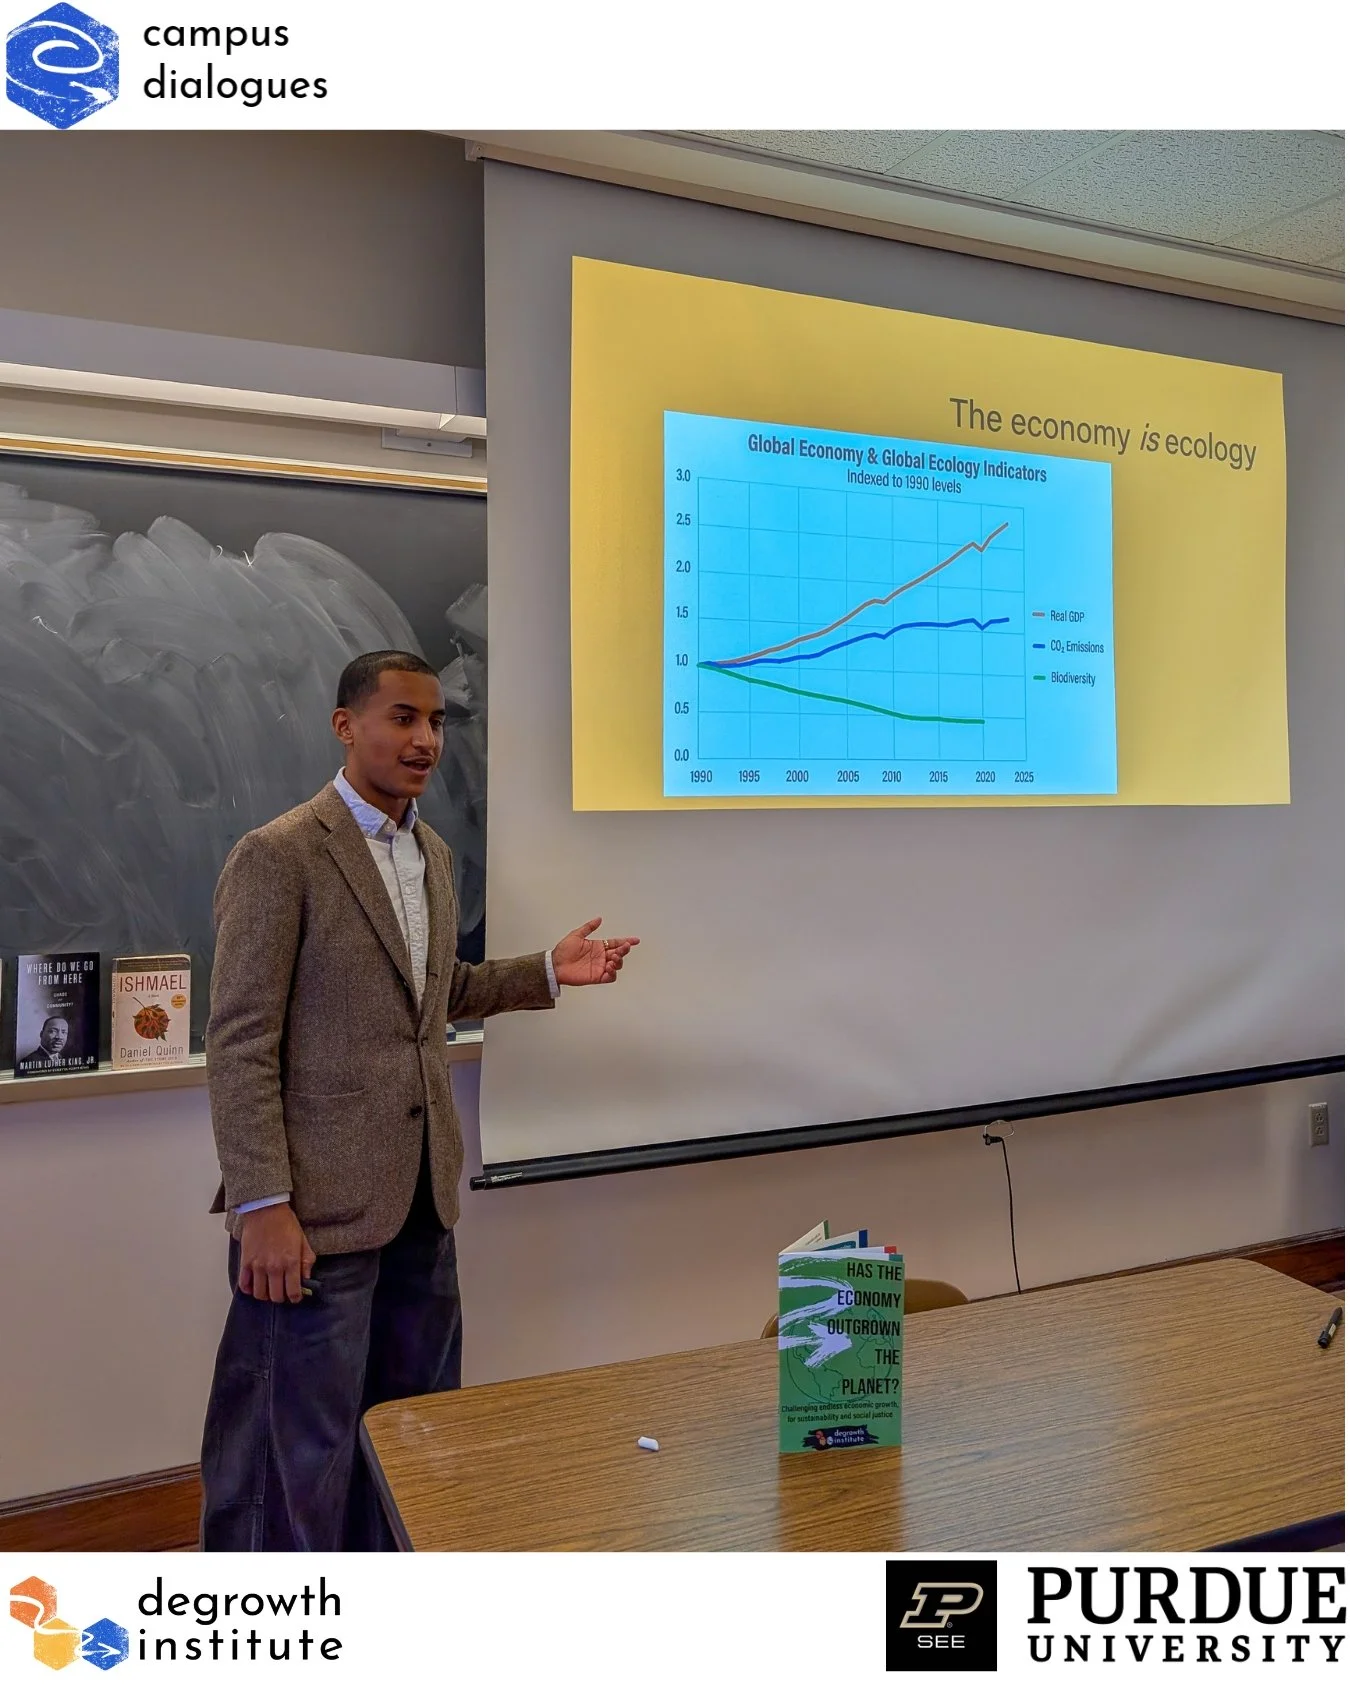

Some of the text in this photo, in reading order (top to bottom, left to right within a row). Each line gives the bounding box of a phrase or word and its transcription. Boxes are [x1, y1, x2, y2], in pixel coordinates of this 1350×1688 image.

[950, 397, 1257, 471] The economy is ecology
[748, 433, 1047, 483] Global Economy & Global Ecology Indicators
[676, 468, 691, 482] 3.0
[847, 468, 962, 494] Indexed to 1990 levels
[676, 513, 691, 526] 2.5
[676, 560, 691, 573] 2.0
[675, 606, 689, 619] 1.5
[1050, 610, 1084, 622] Real GDP
[1066, 641, 1104, 653] Emissions
[675, 654, 688, 667] 1.0
[1051, 671, 1096, 687] Biodiversity
[674, 702, 689, 715] 0.5
[674, 748, 689, 762] 0.0
[690, 770, 713, 783] 1990
[738, 770, 760, 783] 1995
[786, 770, 809, 783] 2000
[837, 770, 860, 783] 2005
[882, 770, 902, 783] 2010
[929, 770, 949, 783] 2015
[975, 770, 996, 783] 2020
[1014, 770, 1035, 783] 2025
[26, 961, 93, 974] WHERE DO WE GO
[38, 973, 82, 985] FROM HERE
[120, 974, 186, 992] ISHMAEL
[120, 1044, 184, 1058] Daniel Quinn
[20, 1061, 42, 1070] MARTIN
[45, 1058, 66, 1068] LUTHER
[847, 1262, 902, 1281] HAS THE
[837, 1290, 901, 1308] ECONOMY
[827, 1319, 900, 1336] OUTGROWN
[875, 1349, 900, 1365] THE
[842, 1378, 899, 1395] PLANET?
[782, 1401, 899, 1413] Challenging endless economic growth,
[787, 1410, 893, 1423] for sustainability and social justice
[834, 1428, 864, 1438] degrowth
[834, 1435, 864, 1444] institute
